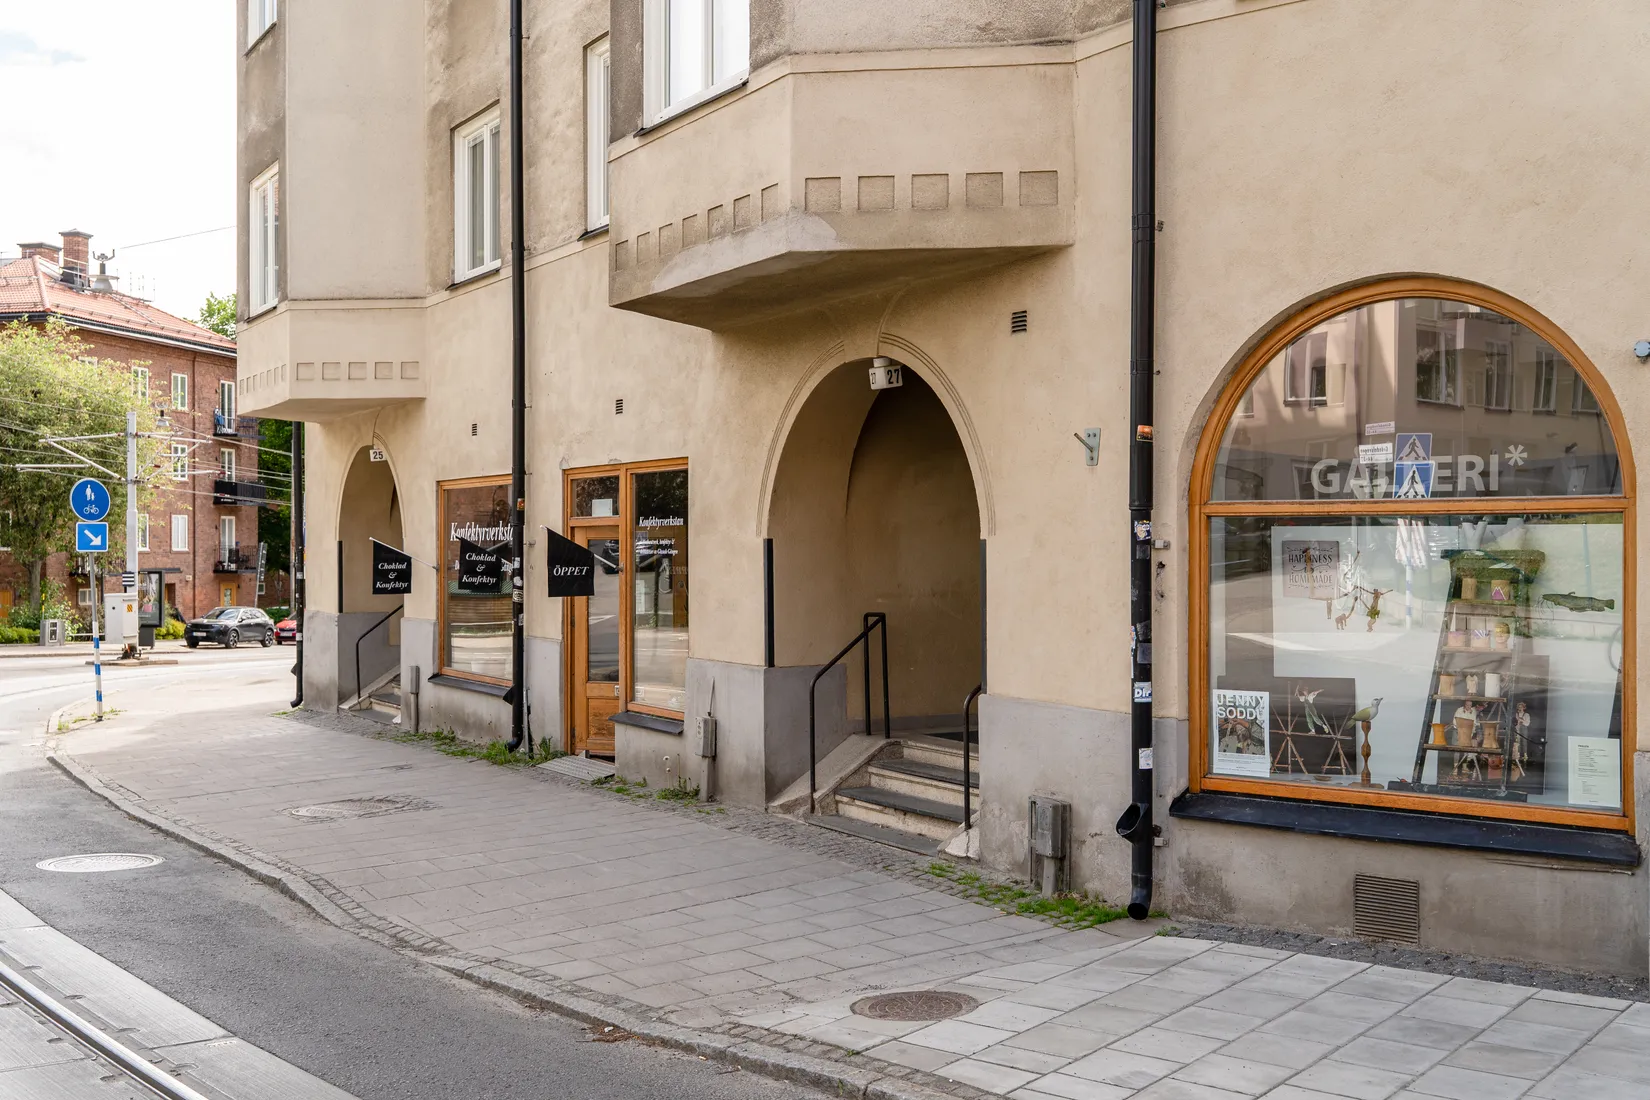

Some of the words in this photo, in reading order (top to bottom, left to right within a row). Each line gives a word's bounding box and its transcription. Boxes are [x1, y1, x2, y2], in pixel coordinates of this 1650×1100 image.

[887, 369, 900, 384] 27
[372, 451, 384, 460] 25
[465, 552, 497, 562] Choklad
[378, 562, 407, 570] Choklad
[476, 563, 486, 572] &
[553, 565, 590, 576] ÖPPET
[388, 571, 397, 579] &
[462, 574, 497, 585] Konfektyr
[376, 581, 409, 590] Konfektyr
[1217, 694, 1265, 707] JENNY
